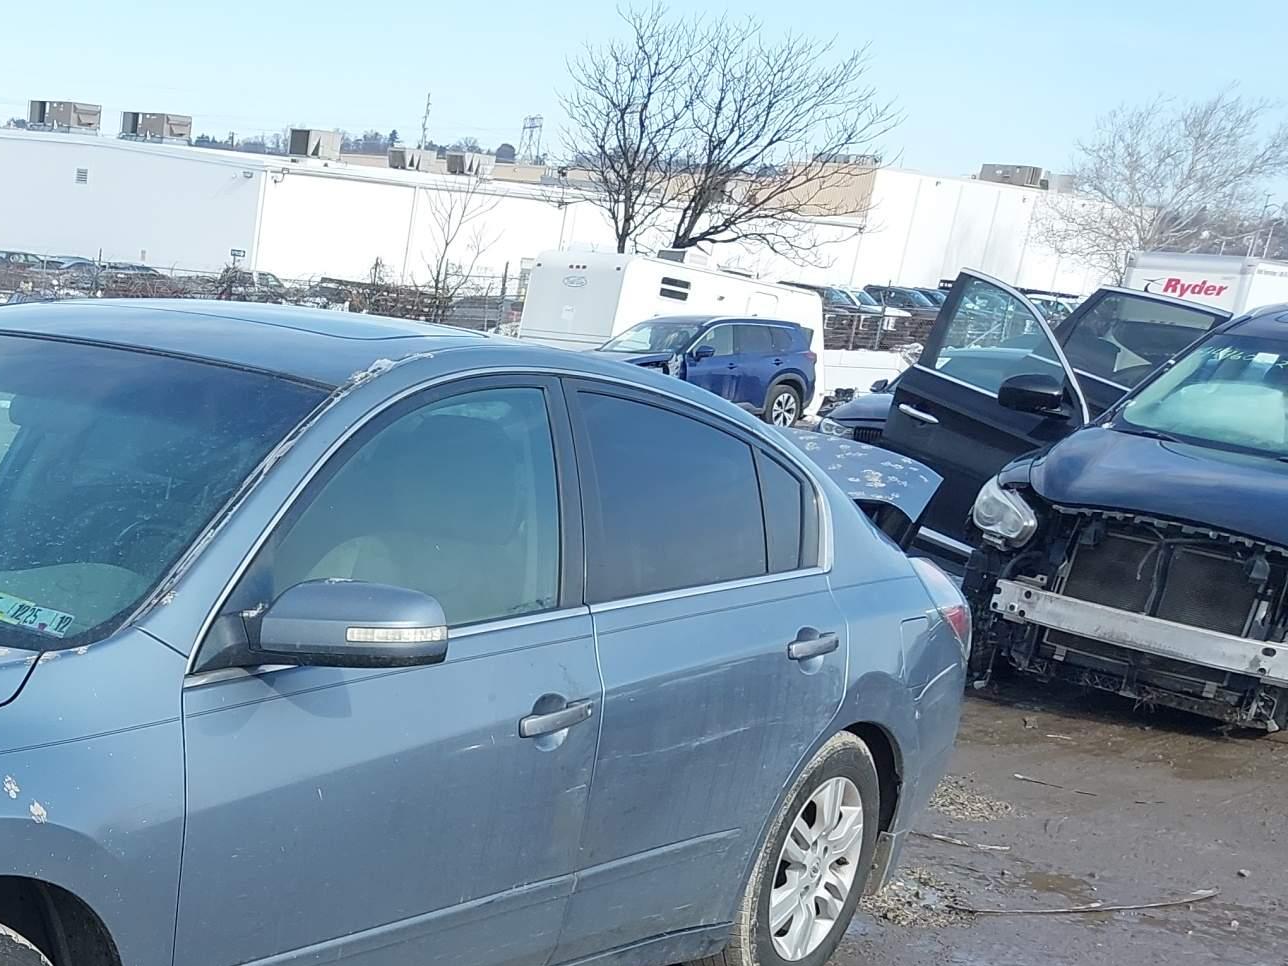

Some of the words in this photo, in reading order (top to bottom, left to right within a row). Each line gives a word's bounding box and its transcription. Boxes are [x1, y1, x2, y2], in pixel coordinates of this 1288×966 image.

[1162, 277, 1229, 298] Ryder
[10, 603, 30, 621] 12
[23, 605, 42, 625] 25
[53, 615, 74, 634] 12
